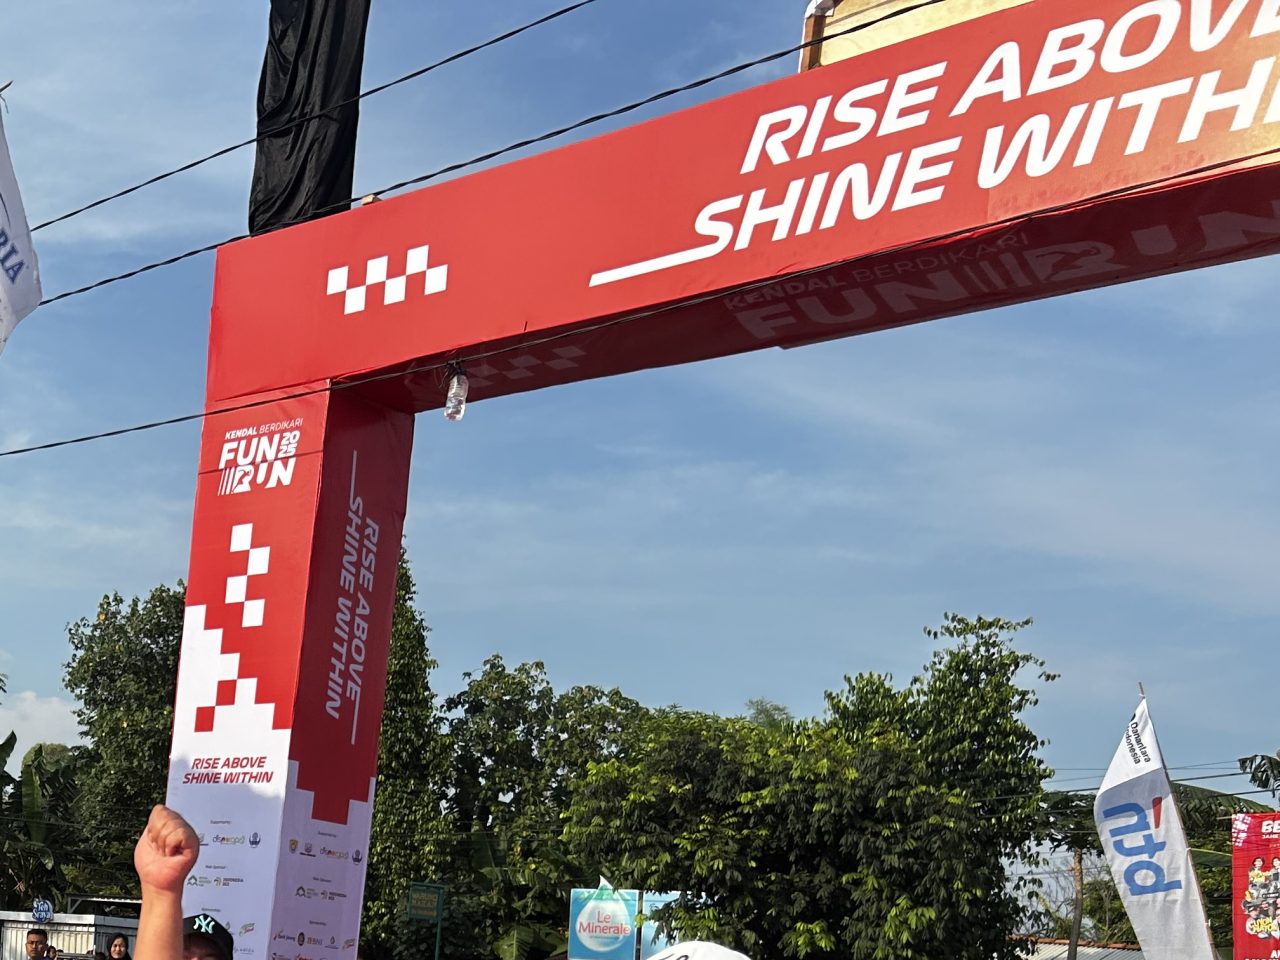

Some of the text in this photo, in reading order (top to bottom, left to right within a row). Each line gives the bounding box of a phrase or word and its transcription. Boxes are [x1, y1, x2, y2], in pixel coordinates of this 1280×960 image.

[740, 0, 1280, 174] RISE ABOV
[693, 136, 962, 263] SHINE
[723, 231, 1028, 312] KENDAL BERDIKARI
[734, 271, 971, 340] FUN
[225, 418, 304, 440] KENDAL BERDIKARI
[219, 431, 300, 470] FUN 20
[278, 443, 297, 458] 25
[228, 457, 297, 495] RUN
[325, 496, 364, 719] SHINE WITHIN
[346, 516, 380, 702] RISE ABOVE
[183, 771, 273, 785] SHINE WITHIN
[192, 756, 267, 770] RISE ABOVE
[578, 922, 631, 936] Minerale
[596, 911, 612, 923] Le
